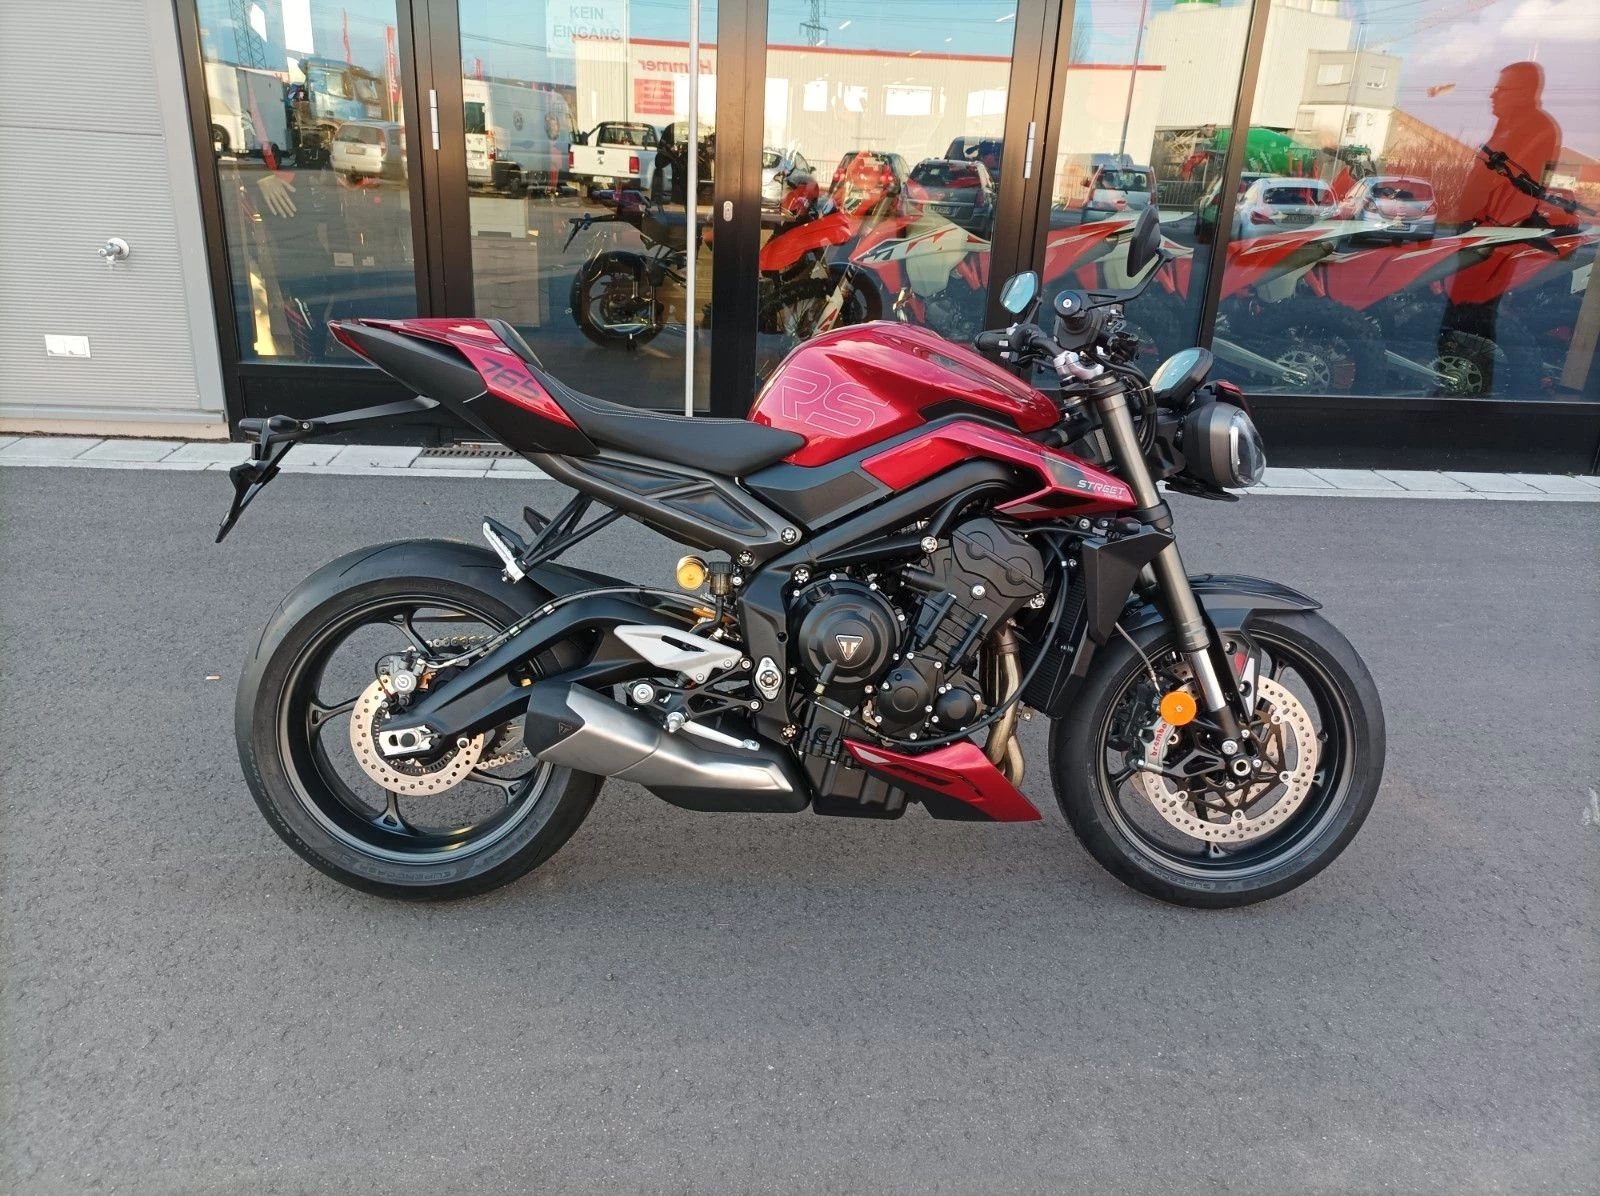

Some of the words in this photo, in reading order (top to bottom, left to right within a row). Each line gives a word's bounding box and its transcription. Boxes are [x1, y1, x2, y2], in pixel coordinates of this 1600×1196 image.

[569, 6, 604, 20] KEIN
[553, 24, 621, 41] EINGANG
[482, 357, 540, 400] 765
[781, 365, 890, 436] RS
[1077, 479, 1126, 495] STREET
[1150, 723, 1168, 757] brembo
